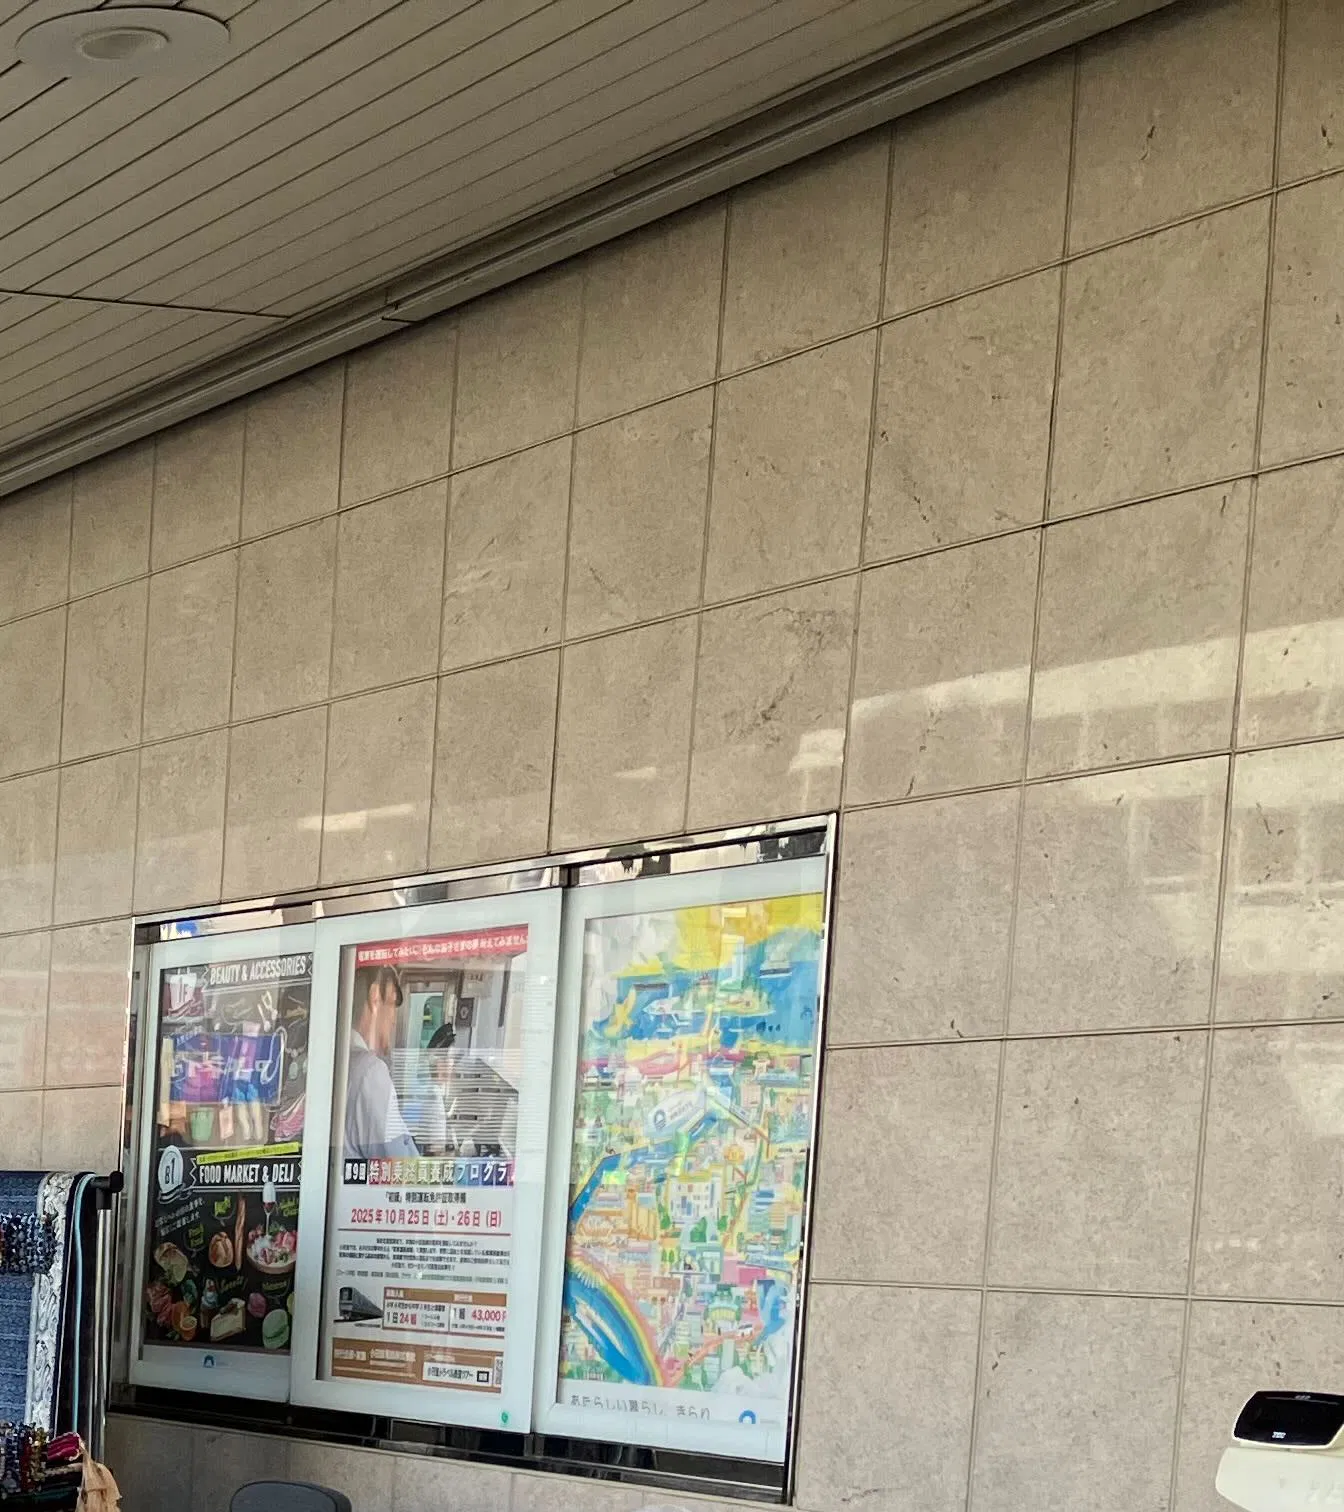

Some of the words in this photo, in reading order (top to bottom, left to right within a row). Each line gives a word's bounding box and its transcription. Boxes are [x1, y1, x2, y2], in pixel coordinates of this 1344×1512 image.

[210, 966, 241, 985] BEAUTY
[249, 956, 306, 980] ACCESSORIES
[165, 1158, 176, 1185] B1
[199, 1165, 222, 1183] FOOD
[223, 1164, 259, 1183] MARKET
[262, 1164, 269, 1182] &
[272, 1163, 294, 1183] DELI
